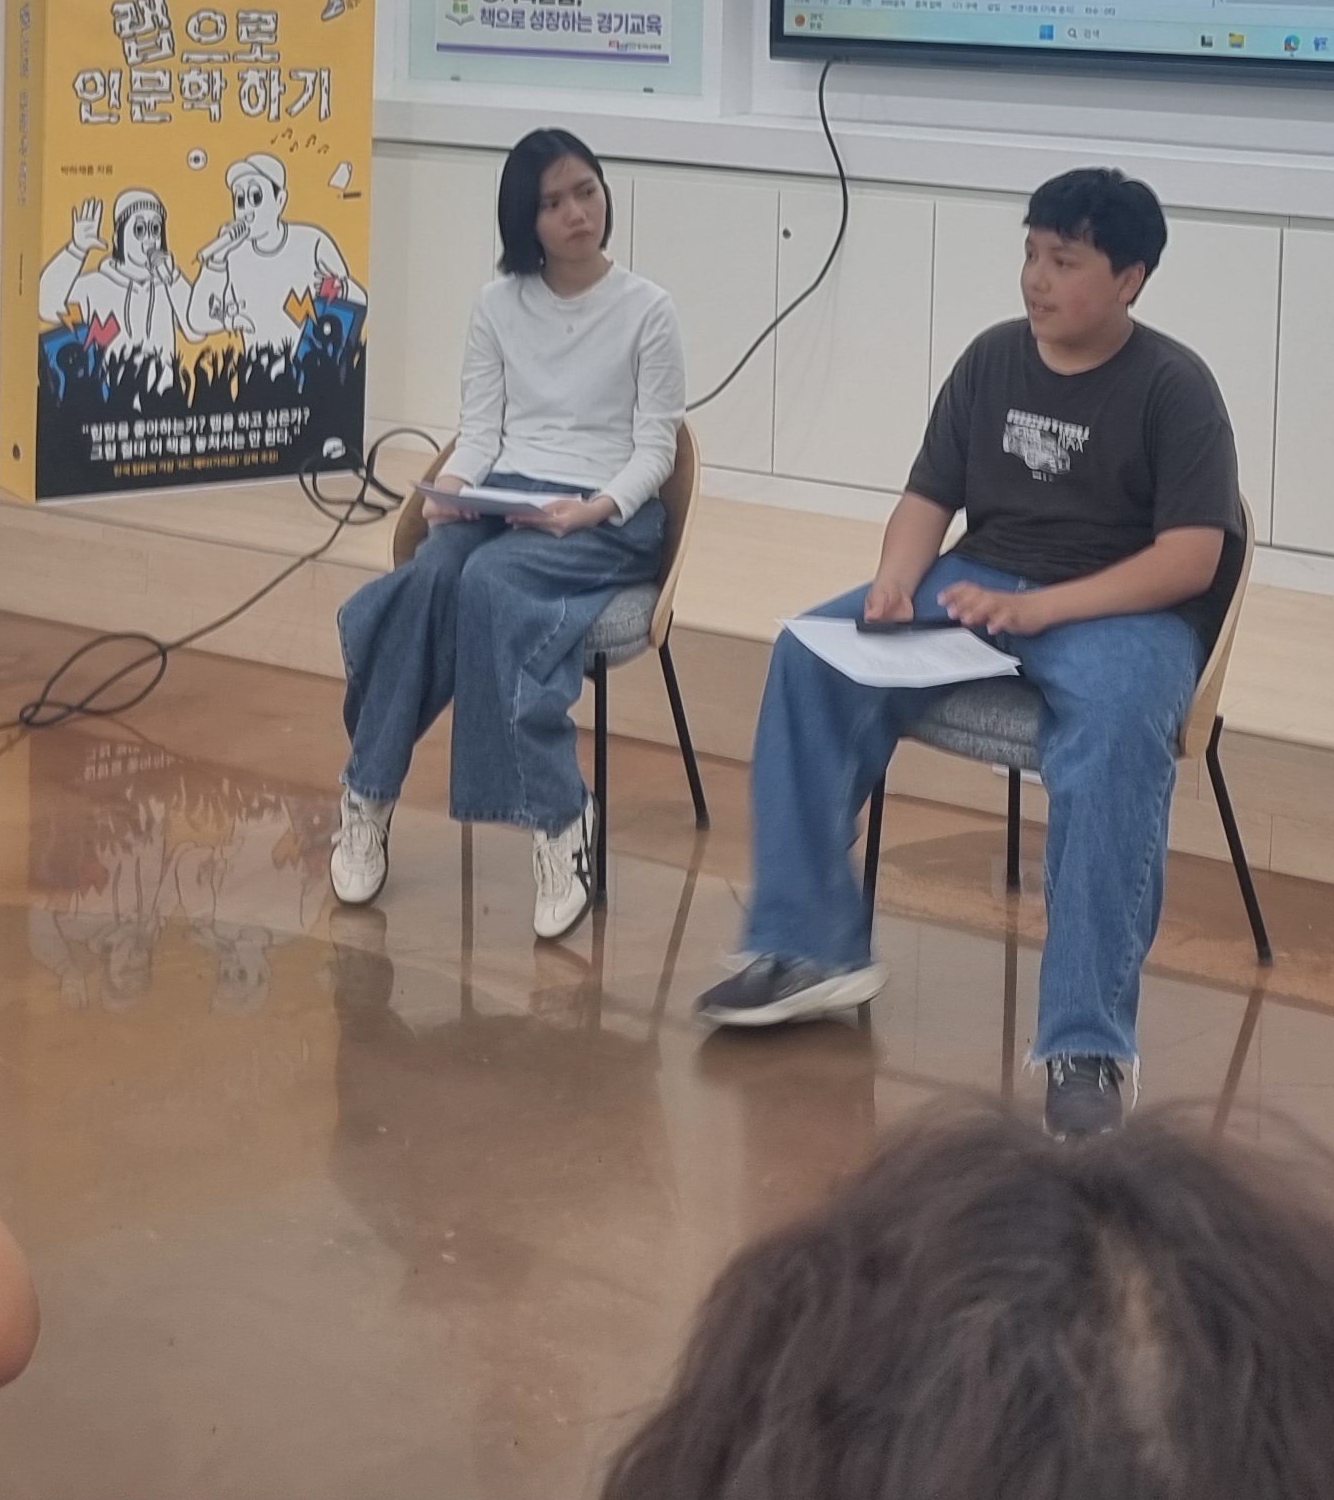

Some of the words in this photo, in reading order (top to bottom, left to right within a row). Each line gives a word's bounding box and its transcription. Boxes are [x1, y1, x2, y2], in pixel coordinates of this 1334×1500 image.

[480, 6, 526, 30] 책으로
[530, 8, 593, 33] 성장하는
[597, 11, 662, 36] 경기교육
[73, 65, 227, 124] 인문학
[237, 66, 331, 123] 하기
[238, 410, 263, 430] 하고
